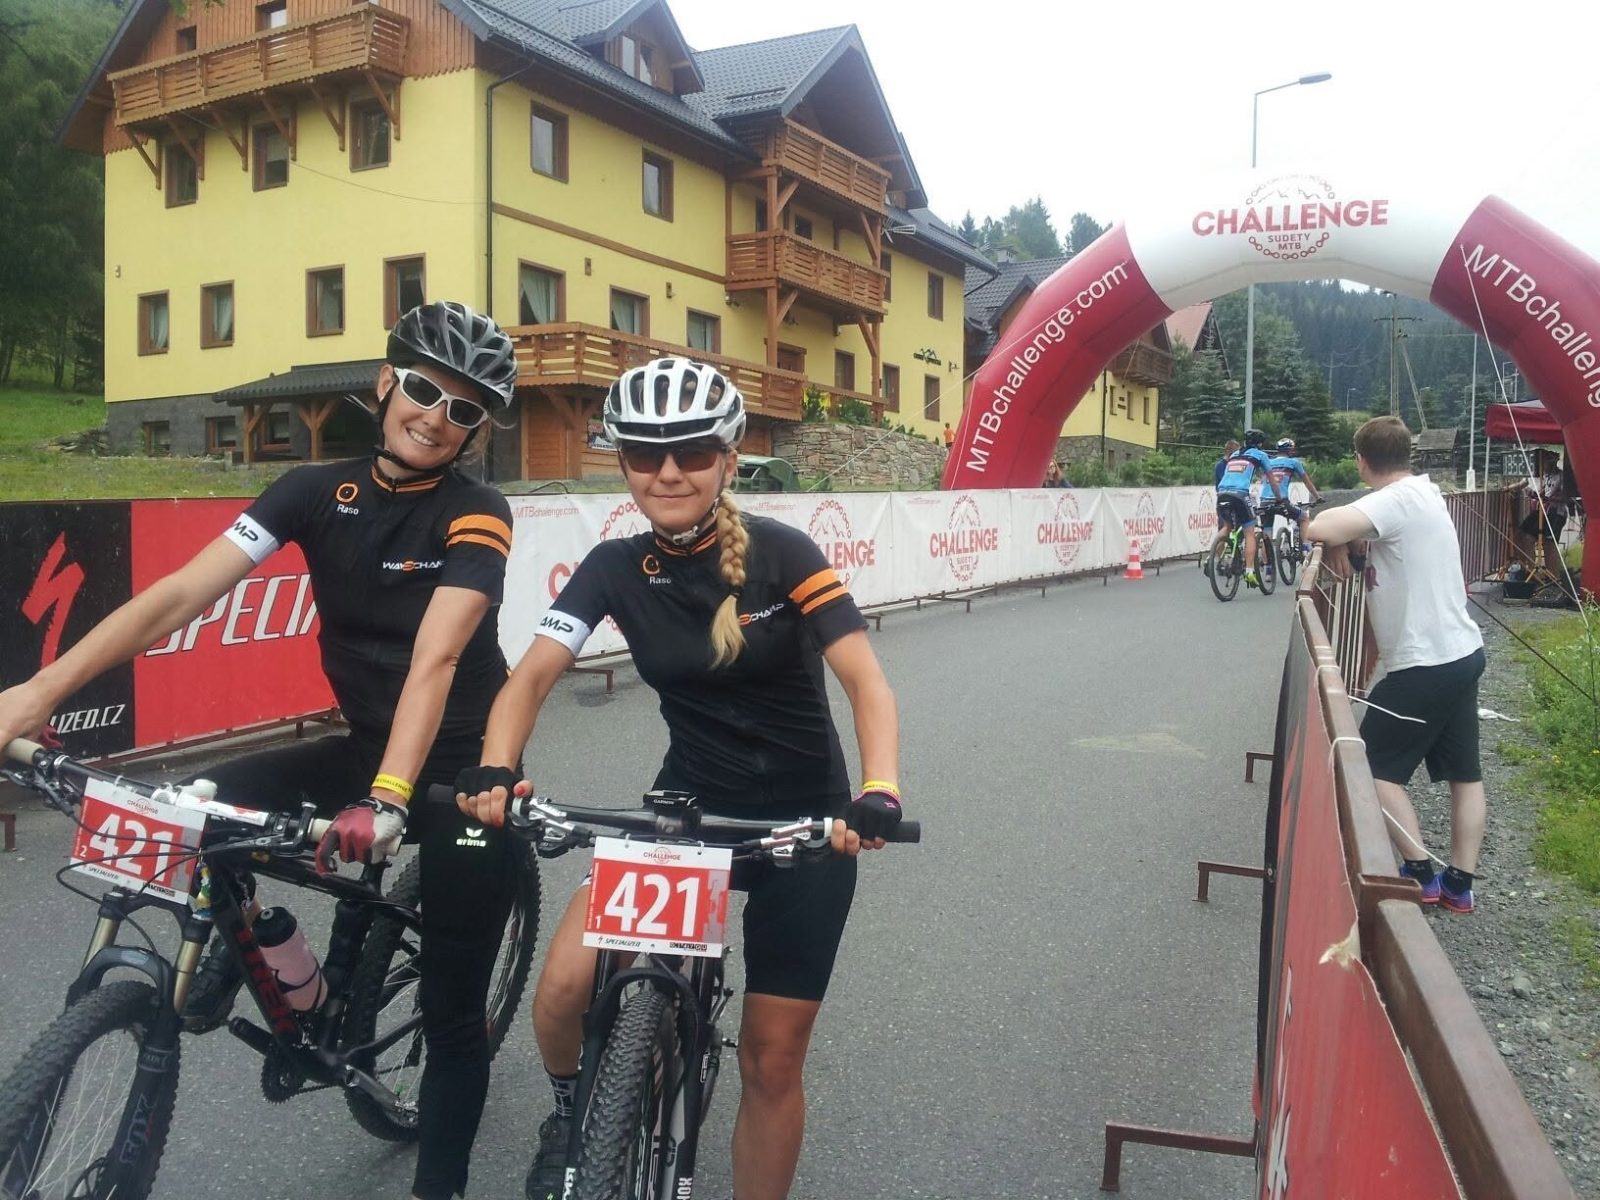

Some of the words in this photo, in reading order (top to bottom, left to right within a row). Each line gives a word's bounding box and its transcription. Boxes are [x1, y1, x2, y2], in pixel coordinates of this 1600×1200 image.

[1192, 200, 1389, 236] CHALLENGE
[1268, 233, 1311, 243] SUDETY
[1278, 242, 1302, 250] MTB
[965, 262, 1128, 473] MTBchallenge.com
[337, 504, 359, 515] Raso
[930, 527, 998, 558] CHALLENGE
[649, 576, 672, 585] Raso
[79, 845, 88, 858] 2
[89, 813, 174, 882] 421
[643, 852, 681, 861] CHALLENGE
[604, 871, 700, 938] 421
[595, 915, 601, 930] 1
